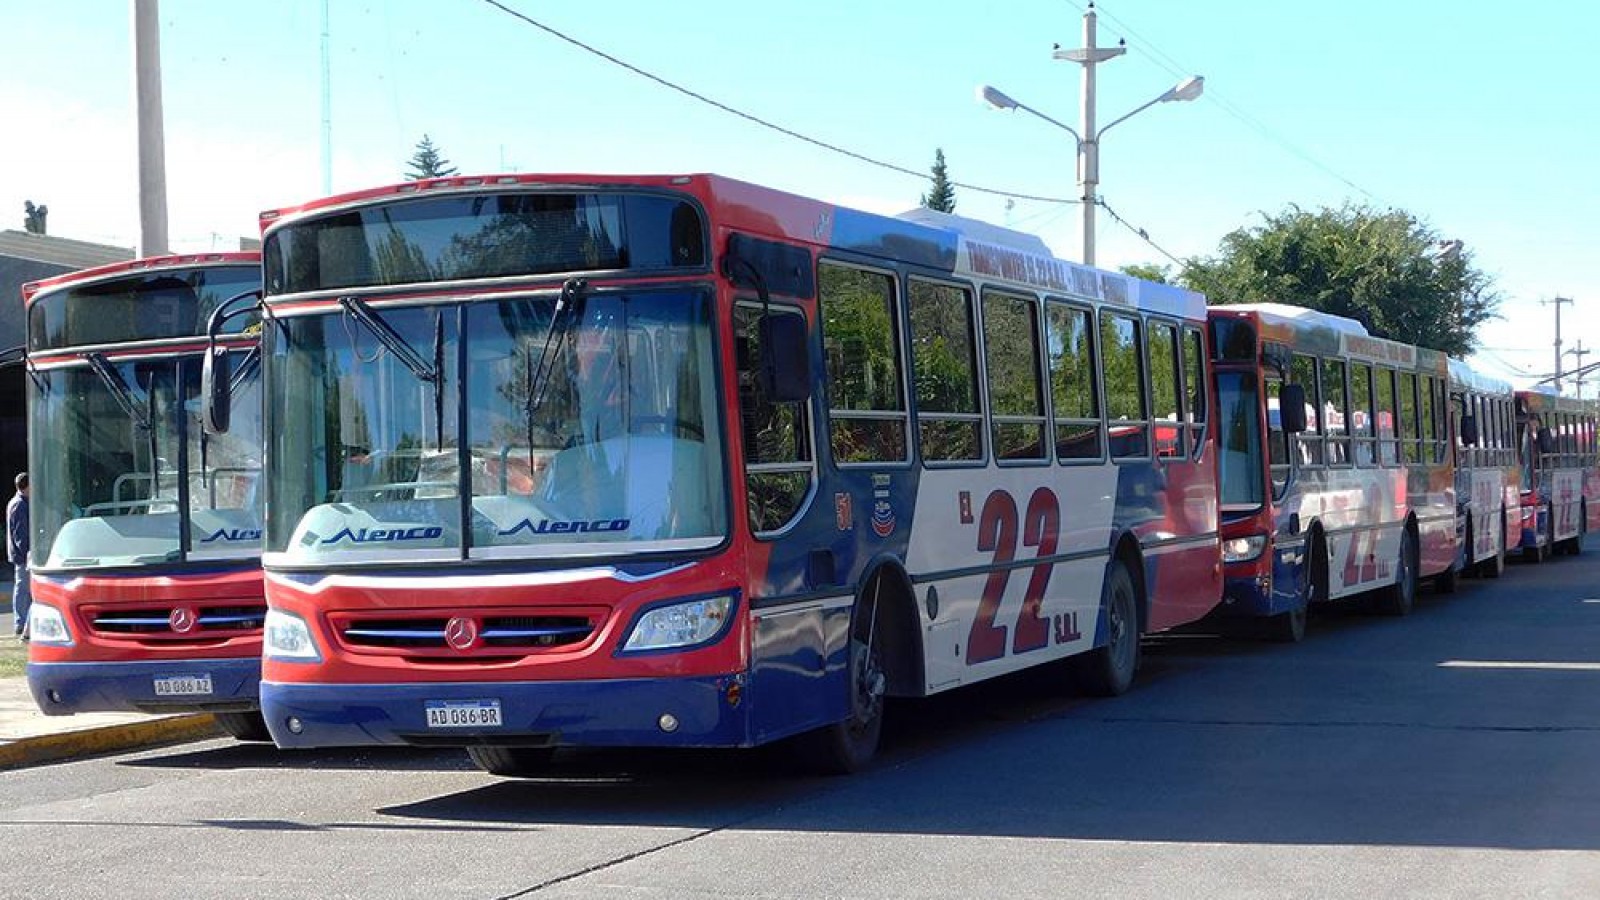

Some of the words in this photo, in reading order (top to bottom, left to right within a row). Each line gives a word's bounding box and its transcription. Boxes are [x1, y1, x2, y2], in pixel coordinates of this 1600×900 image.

[959, 490, 974, 524] EL
[321, 526, 443, 544] Alenco
[498, 518, 630, 536] Alenco
[966, 486, 1061, 666] 22
[430, 709, 448, 725] AD
[450, 708, 477, 725] 086
[479, 708, 498, 724] BR
